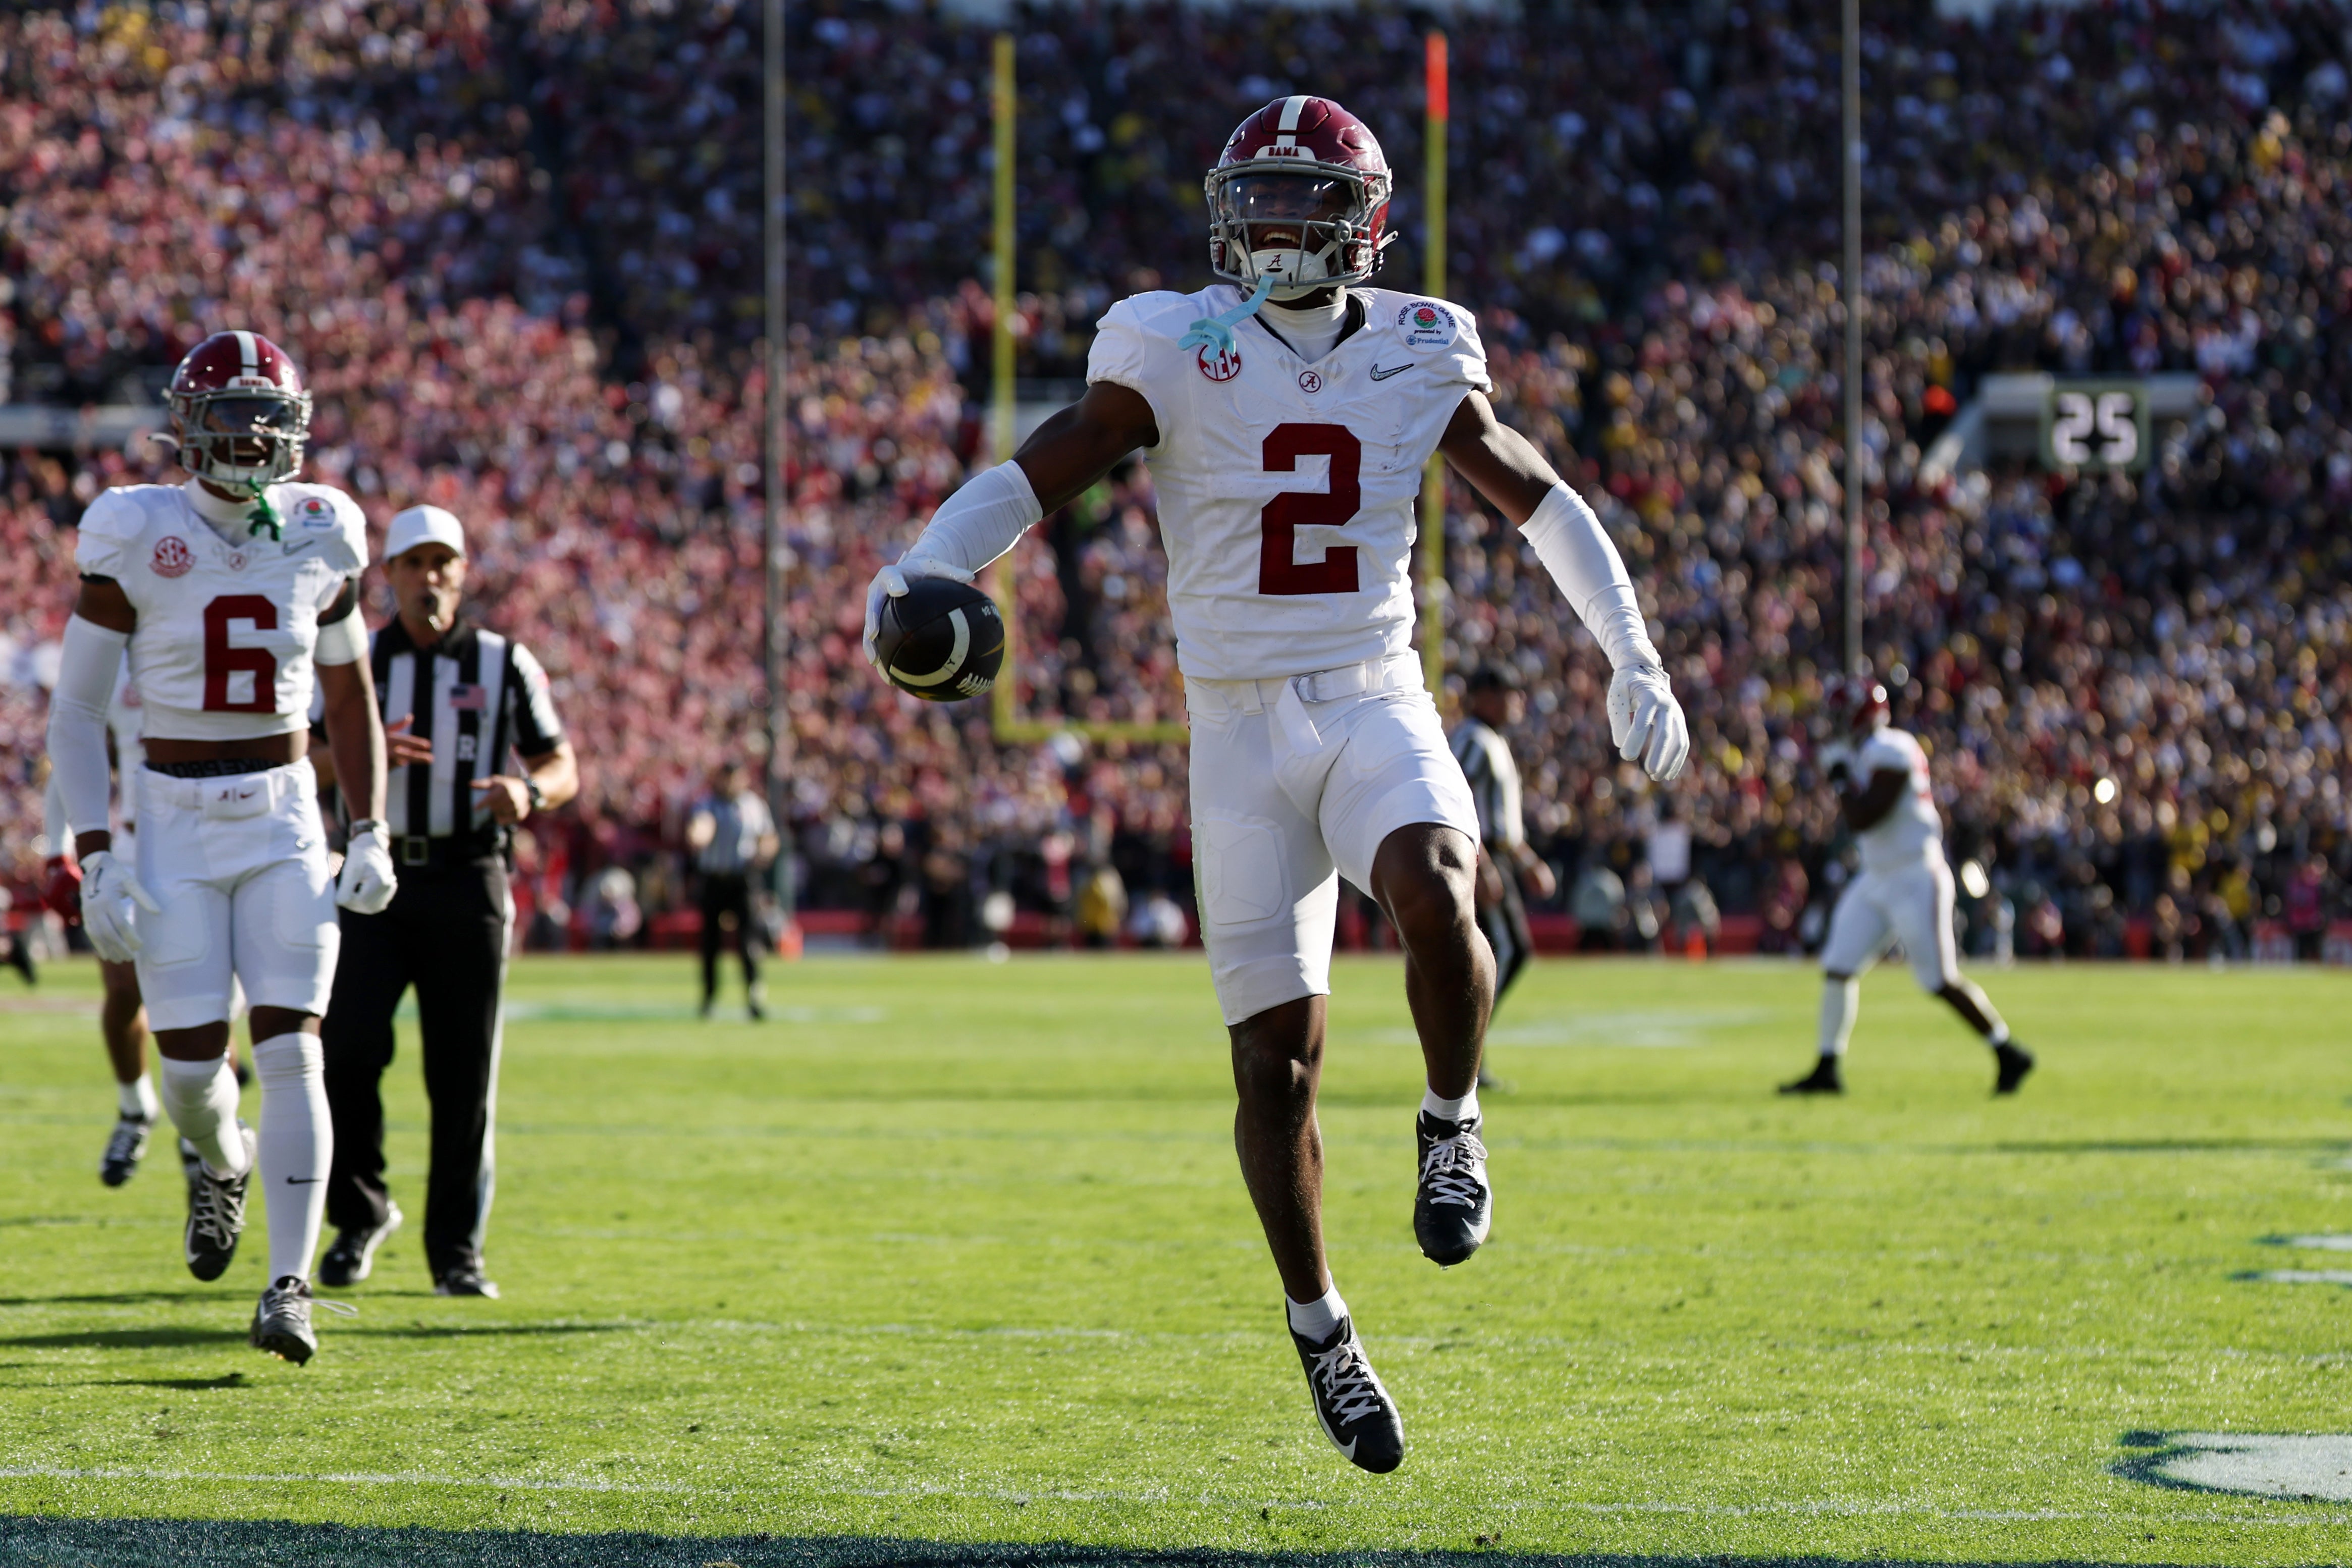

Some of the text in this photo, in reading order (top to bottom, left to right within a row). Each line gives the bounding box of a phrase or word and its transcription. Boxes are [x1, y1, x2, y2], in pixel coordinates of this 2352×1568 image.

[1268, 146, 1300, 156] BAMA
[1398, 306, 1411, 325] ROSE
[1438, 307, 1456, 328] GAME
[2052, 392, 2138, 464] 25
[1259, 423, 1361, 595] 2
[203, 594, 277, 714] 6
[458, 735, 476, 760] R
